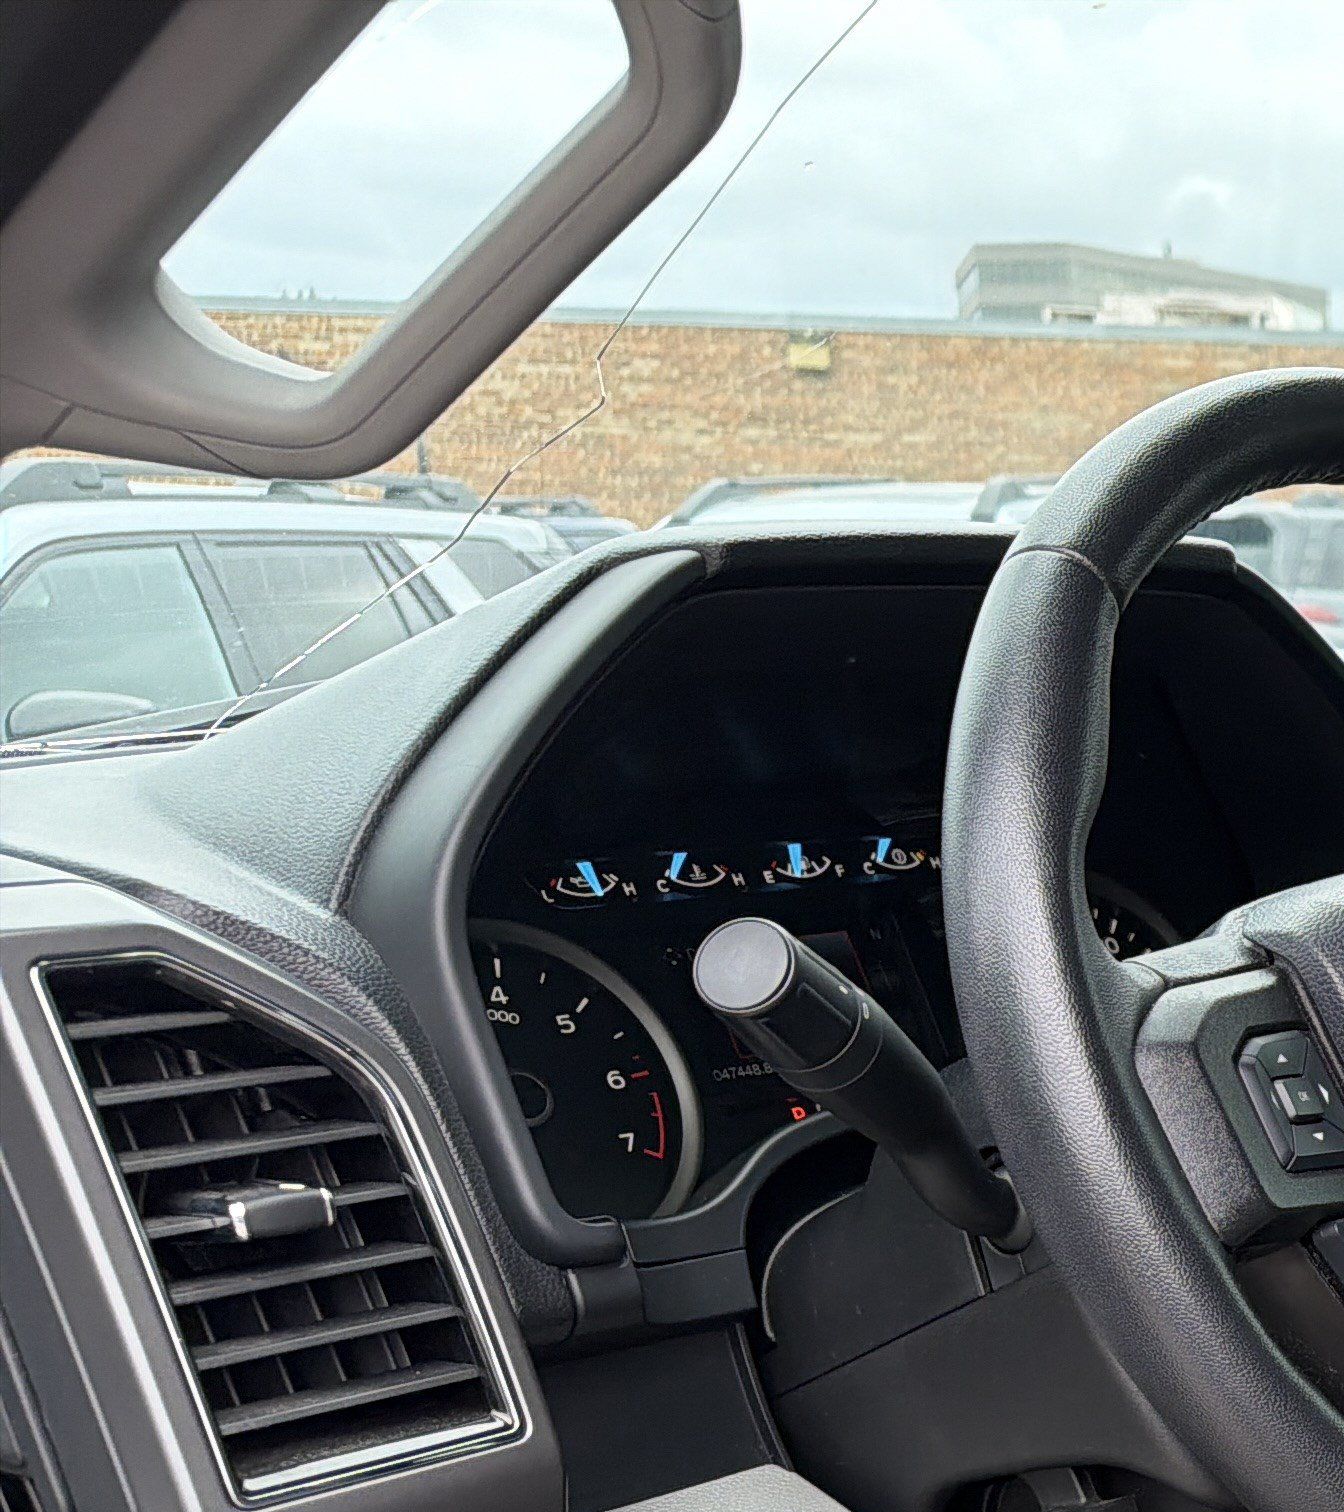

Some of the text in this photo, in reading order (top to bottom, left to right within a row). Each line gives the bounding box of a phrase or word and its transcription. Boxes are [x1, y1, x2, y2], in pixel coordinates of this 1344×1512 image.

[834, 864, 846, 878] F
[862, 861, 876, 875] C
[731, 872, 747, 887] H
[762, 870, 776, 884] E
[621, 881, 638, 896] H
[656, 879, 671, 893] C
[490, 985, 509, 1005] 4
[555, 1013, 577, 1034] 5
[606, 1069, 627, 1090] 6
[791, 1106, 807, 1121] D
[618, 1132, 636, 1153] 7
